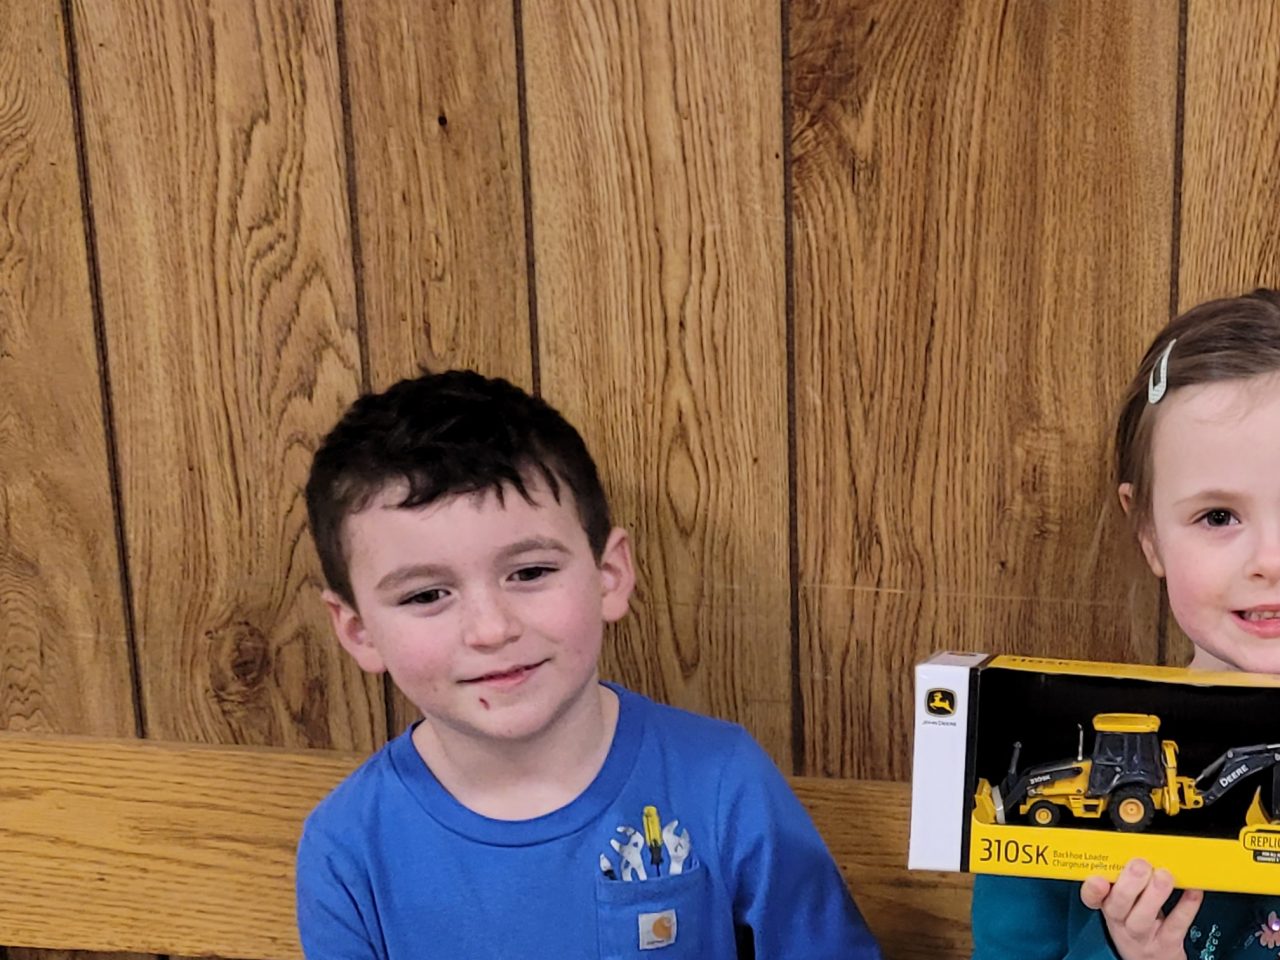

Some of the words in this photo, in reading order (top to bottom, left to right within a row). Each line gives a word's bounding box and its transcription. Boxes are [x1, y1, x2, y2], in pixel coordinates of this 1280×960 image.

[1219, 764, 1249, 788] DEERE
[979, 838, 1049, 865] 310SK
[1053, 850, 1082, 860] Backhoe
[1084, 852, 1109, 861] Loader
